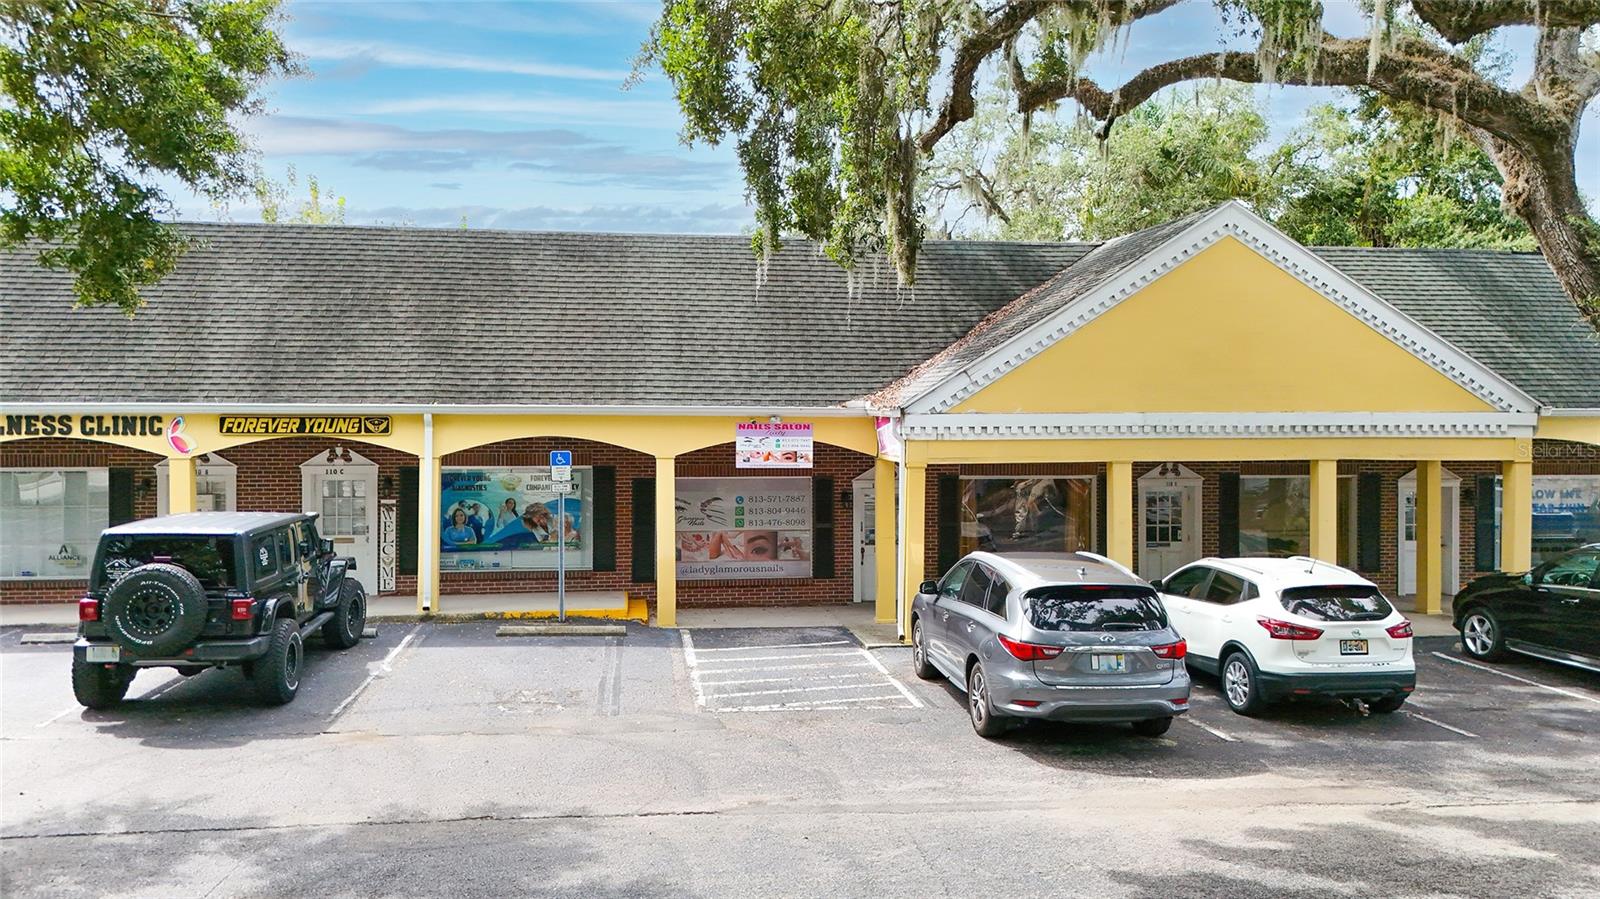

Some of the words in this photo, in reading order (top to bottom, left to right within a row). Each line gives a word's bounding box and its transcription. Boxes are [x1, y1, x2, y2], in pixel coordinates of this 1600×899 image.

[80, 414, 163, 435] CLINIC
[222, 417, 301, 433] FOREVER
[303, 417, 361, 433] YOUNG
[748, 495, 806, 503] 813-571-7887
[748, 506, 806, 514] 813-804-9446
[748, 518, 806, 526] 813-476-8098
[679, 564, 784, 576] @ladyglamorousnails
